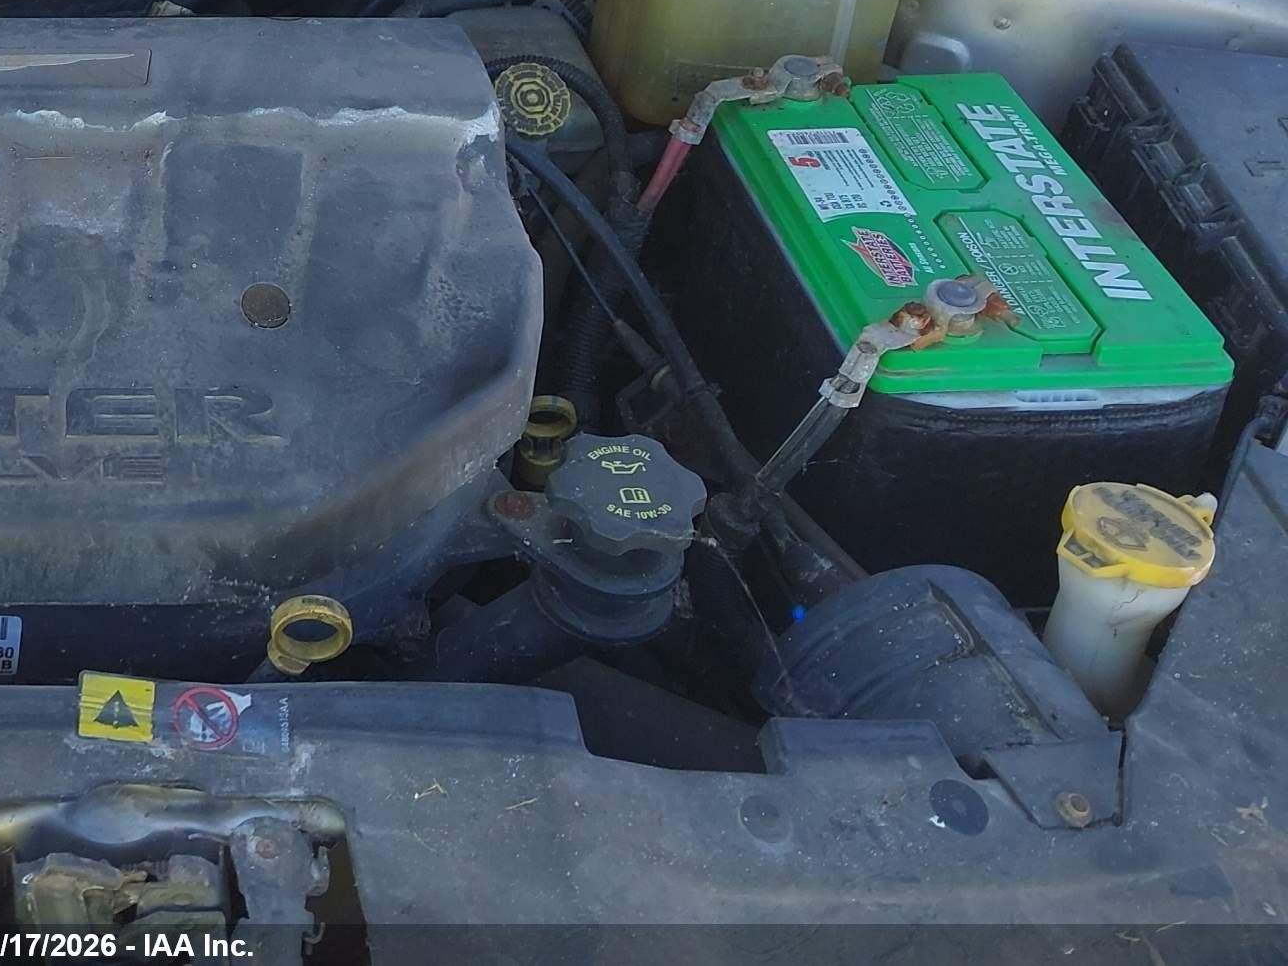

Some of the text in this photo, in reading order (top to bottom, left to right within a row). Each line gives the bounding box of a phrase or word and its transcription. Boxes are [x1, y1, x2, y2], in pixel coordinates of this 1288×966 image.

[788, 156, 821, 168] 5
[1008, 114, 1068, 177] MEGA-TRON
[956, 103, 1153, 301] INTERSTATE
[858, 230, 900, 284] INTERSTATE
[872, 233, 912, 283] BATTERIES
[957, 232, 987, 264] POISON
[986, 270, 1019, 306] DANGER
[586, 445, 653, 462] ENGINE OIL
[605, 503, 673, 520] SAE 10W-30
